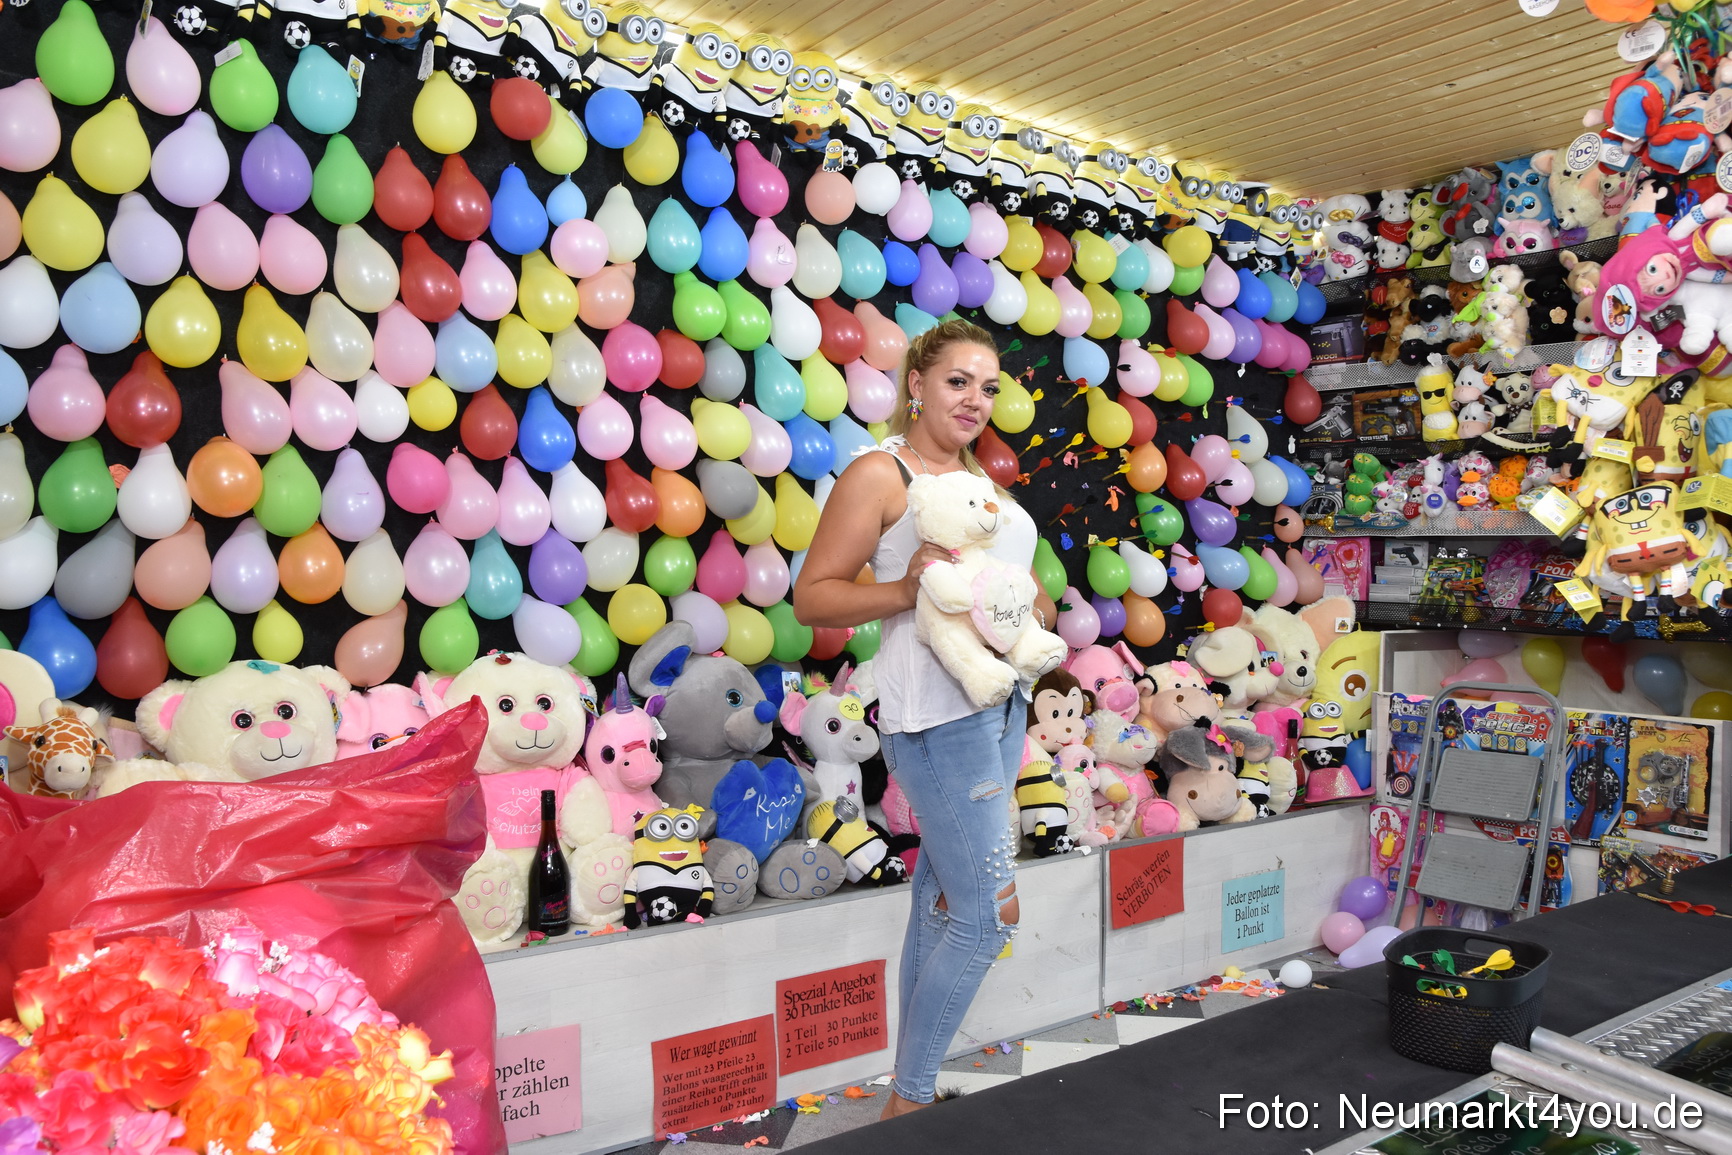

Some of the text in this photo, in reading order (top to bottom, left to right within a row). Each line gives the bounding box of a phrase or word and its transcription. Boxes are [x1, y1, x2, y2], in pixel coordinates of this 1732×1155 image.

[1575, 146, 1592, 158] DC
[1473, 719, 1537, 735] POLICE
[1485, 712, 1531, 724] SUPER
[511, 786, 541, 797] Dein
[756, 794, 797, 817] Kiss
[764, 813, 793, 842] Me
[1519, 826, 1566, 842] POCE
[1116, 849, 1170, 906] Schräg werfen
[1123, 864, 1172, 919] VERBOTEN
[1226, 884, 1280, 906] Jeder geplatzte
[1235, 903, 1269, 922] Ballon ist
[1237, 922, 1264, 939] 1 Punkt
[783, 972, 877, 1008] Spezial Angebot
[785, 989, 876, 1021] 30 Punkte Reihe
[785, 1011, 879, 1043] 1 Teil 30 Punkte
[669, 1029, 757, 1063] Wer wagt gewinnt
[786, 1026, 880, 1058] 2 Teile 50 Punkte
[662, 1053, 755, 1084] Wer mit 23 Pfeile 23
[663, 1062, 765, 1096] Ballons waagerecht in
[512, 1075, 570, 1099] zählen
[662, 1072, 768, 1107] einer Reihe trifft erhält
[501, 1100, 541, 1122] fach
[662, 1086, 757, 1118] zusätzlich 10 Punkte
[720, 1094, 764, 1114] (ab 21uhr)
[662, 1116, 688, 1130] extra!
